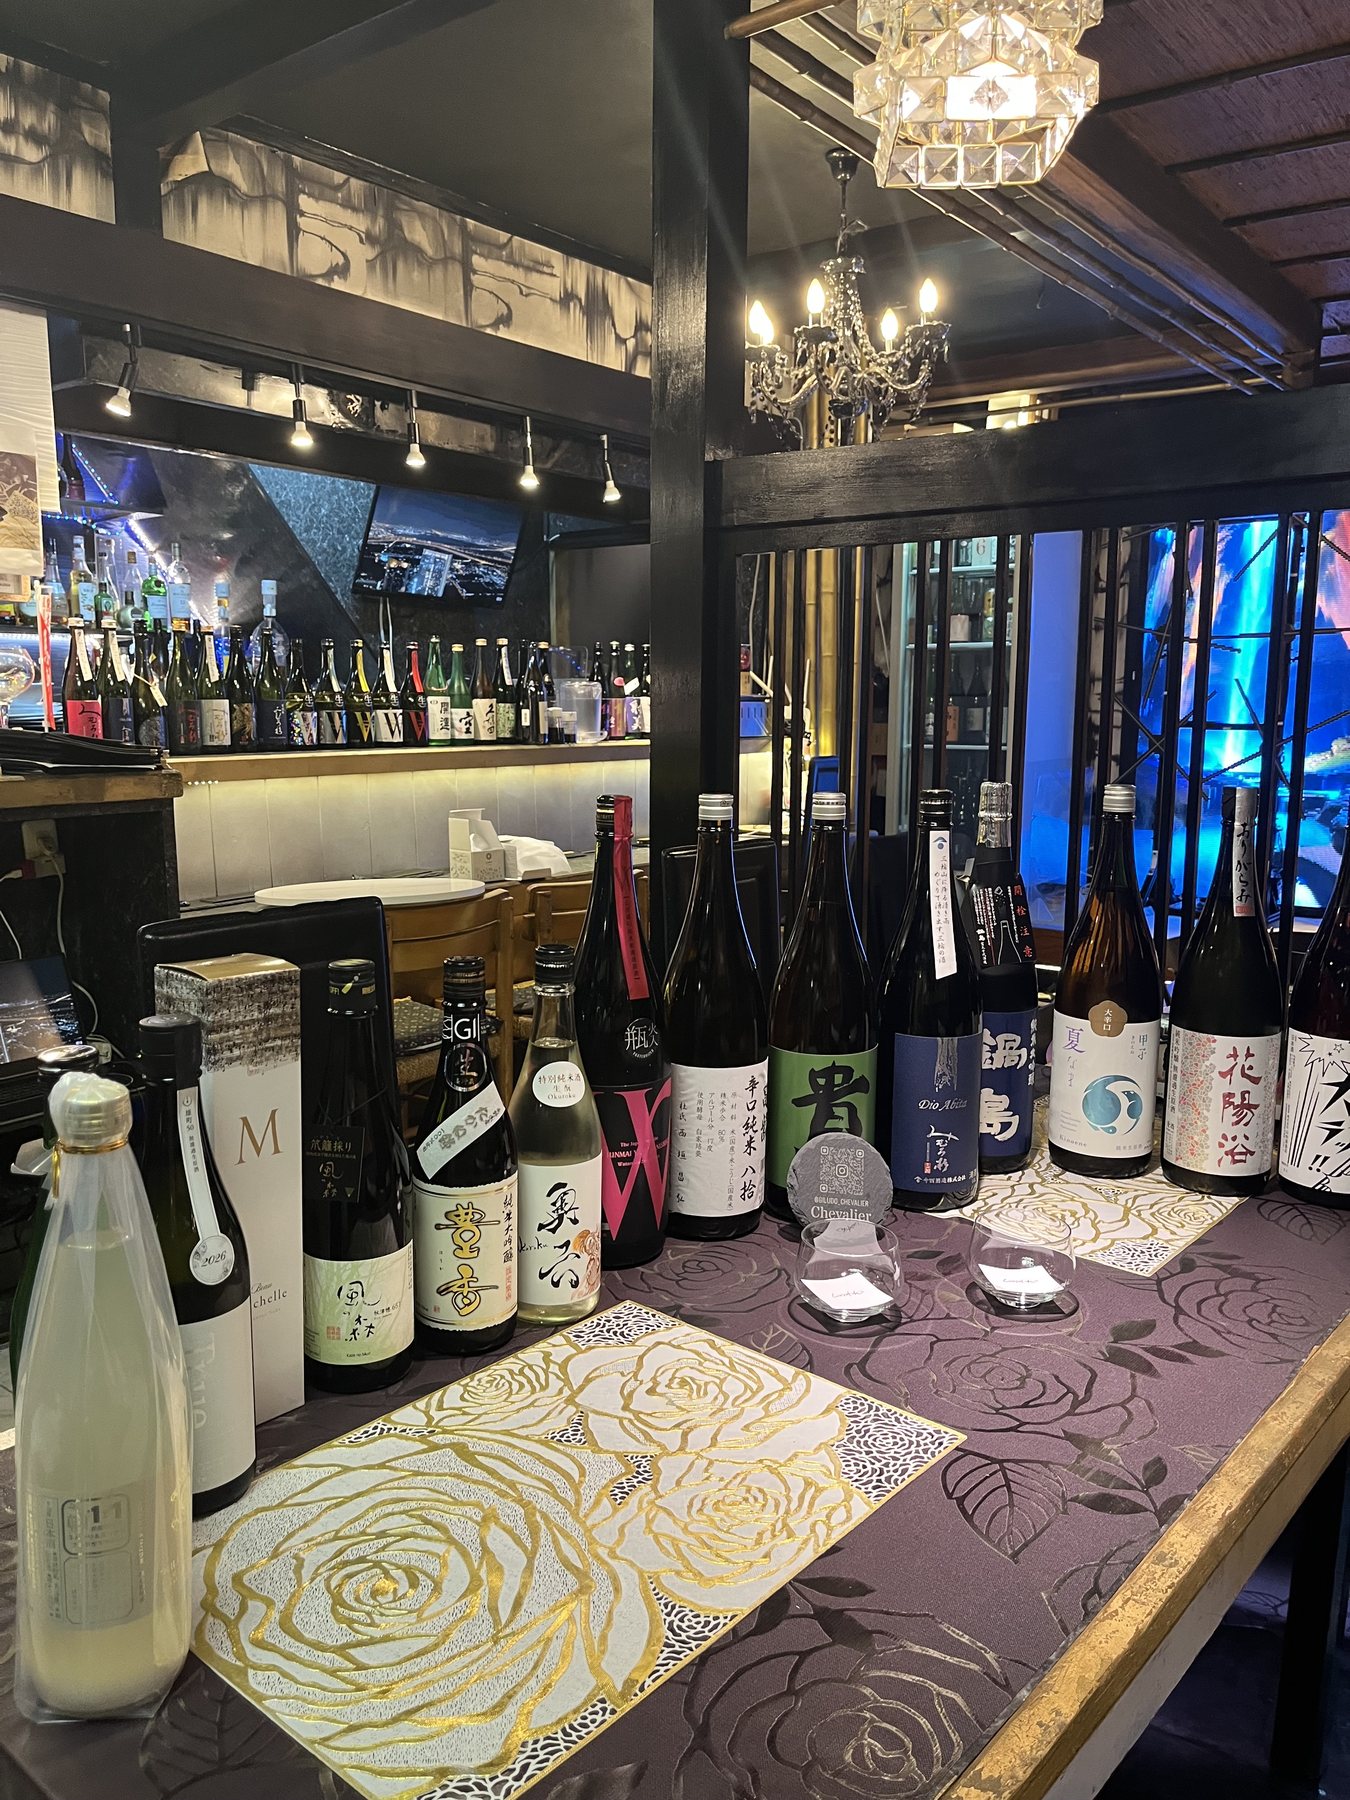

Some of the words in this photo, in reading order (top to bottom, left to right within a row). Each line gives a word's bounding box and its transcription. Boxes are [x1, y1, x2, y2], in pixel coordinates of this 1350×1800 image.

[1235, 822, 1252, 903] おりがらみ
[1014, 885, 1032, 957] 開栓注意
[454, 1018, 476, 1040] GI
[1103, 1009, 1113, 1031] 大辛口
[742, 1075, 759, 1153] 辛口純米
[791, 1060, 870, 1153] 貴
[981, 1028, 1028, 1141] 鍋島
[1218, 1046, 1262, 1167] 花陽浴
[233, 1107, 283, 1166] M
[739, 1165, 757, 1201] 八拾
[811, 1205, 872, 1221] Chevalier
[201, 1251, 227, 1267] 2026
[434, 1201, 500, 1317] 豊香
[502, 1193, 514, 1264] 純米大吟醸
[253, 1289, 288, 1309] chelle
